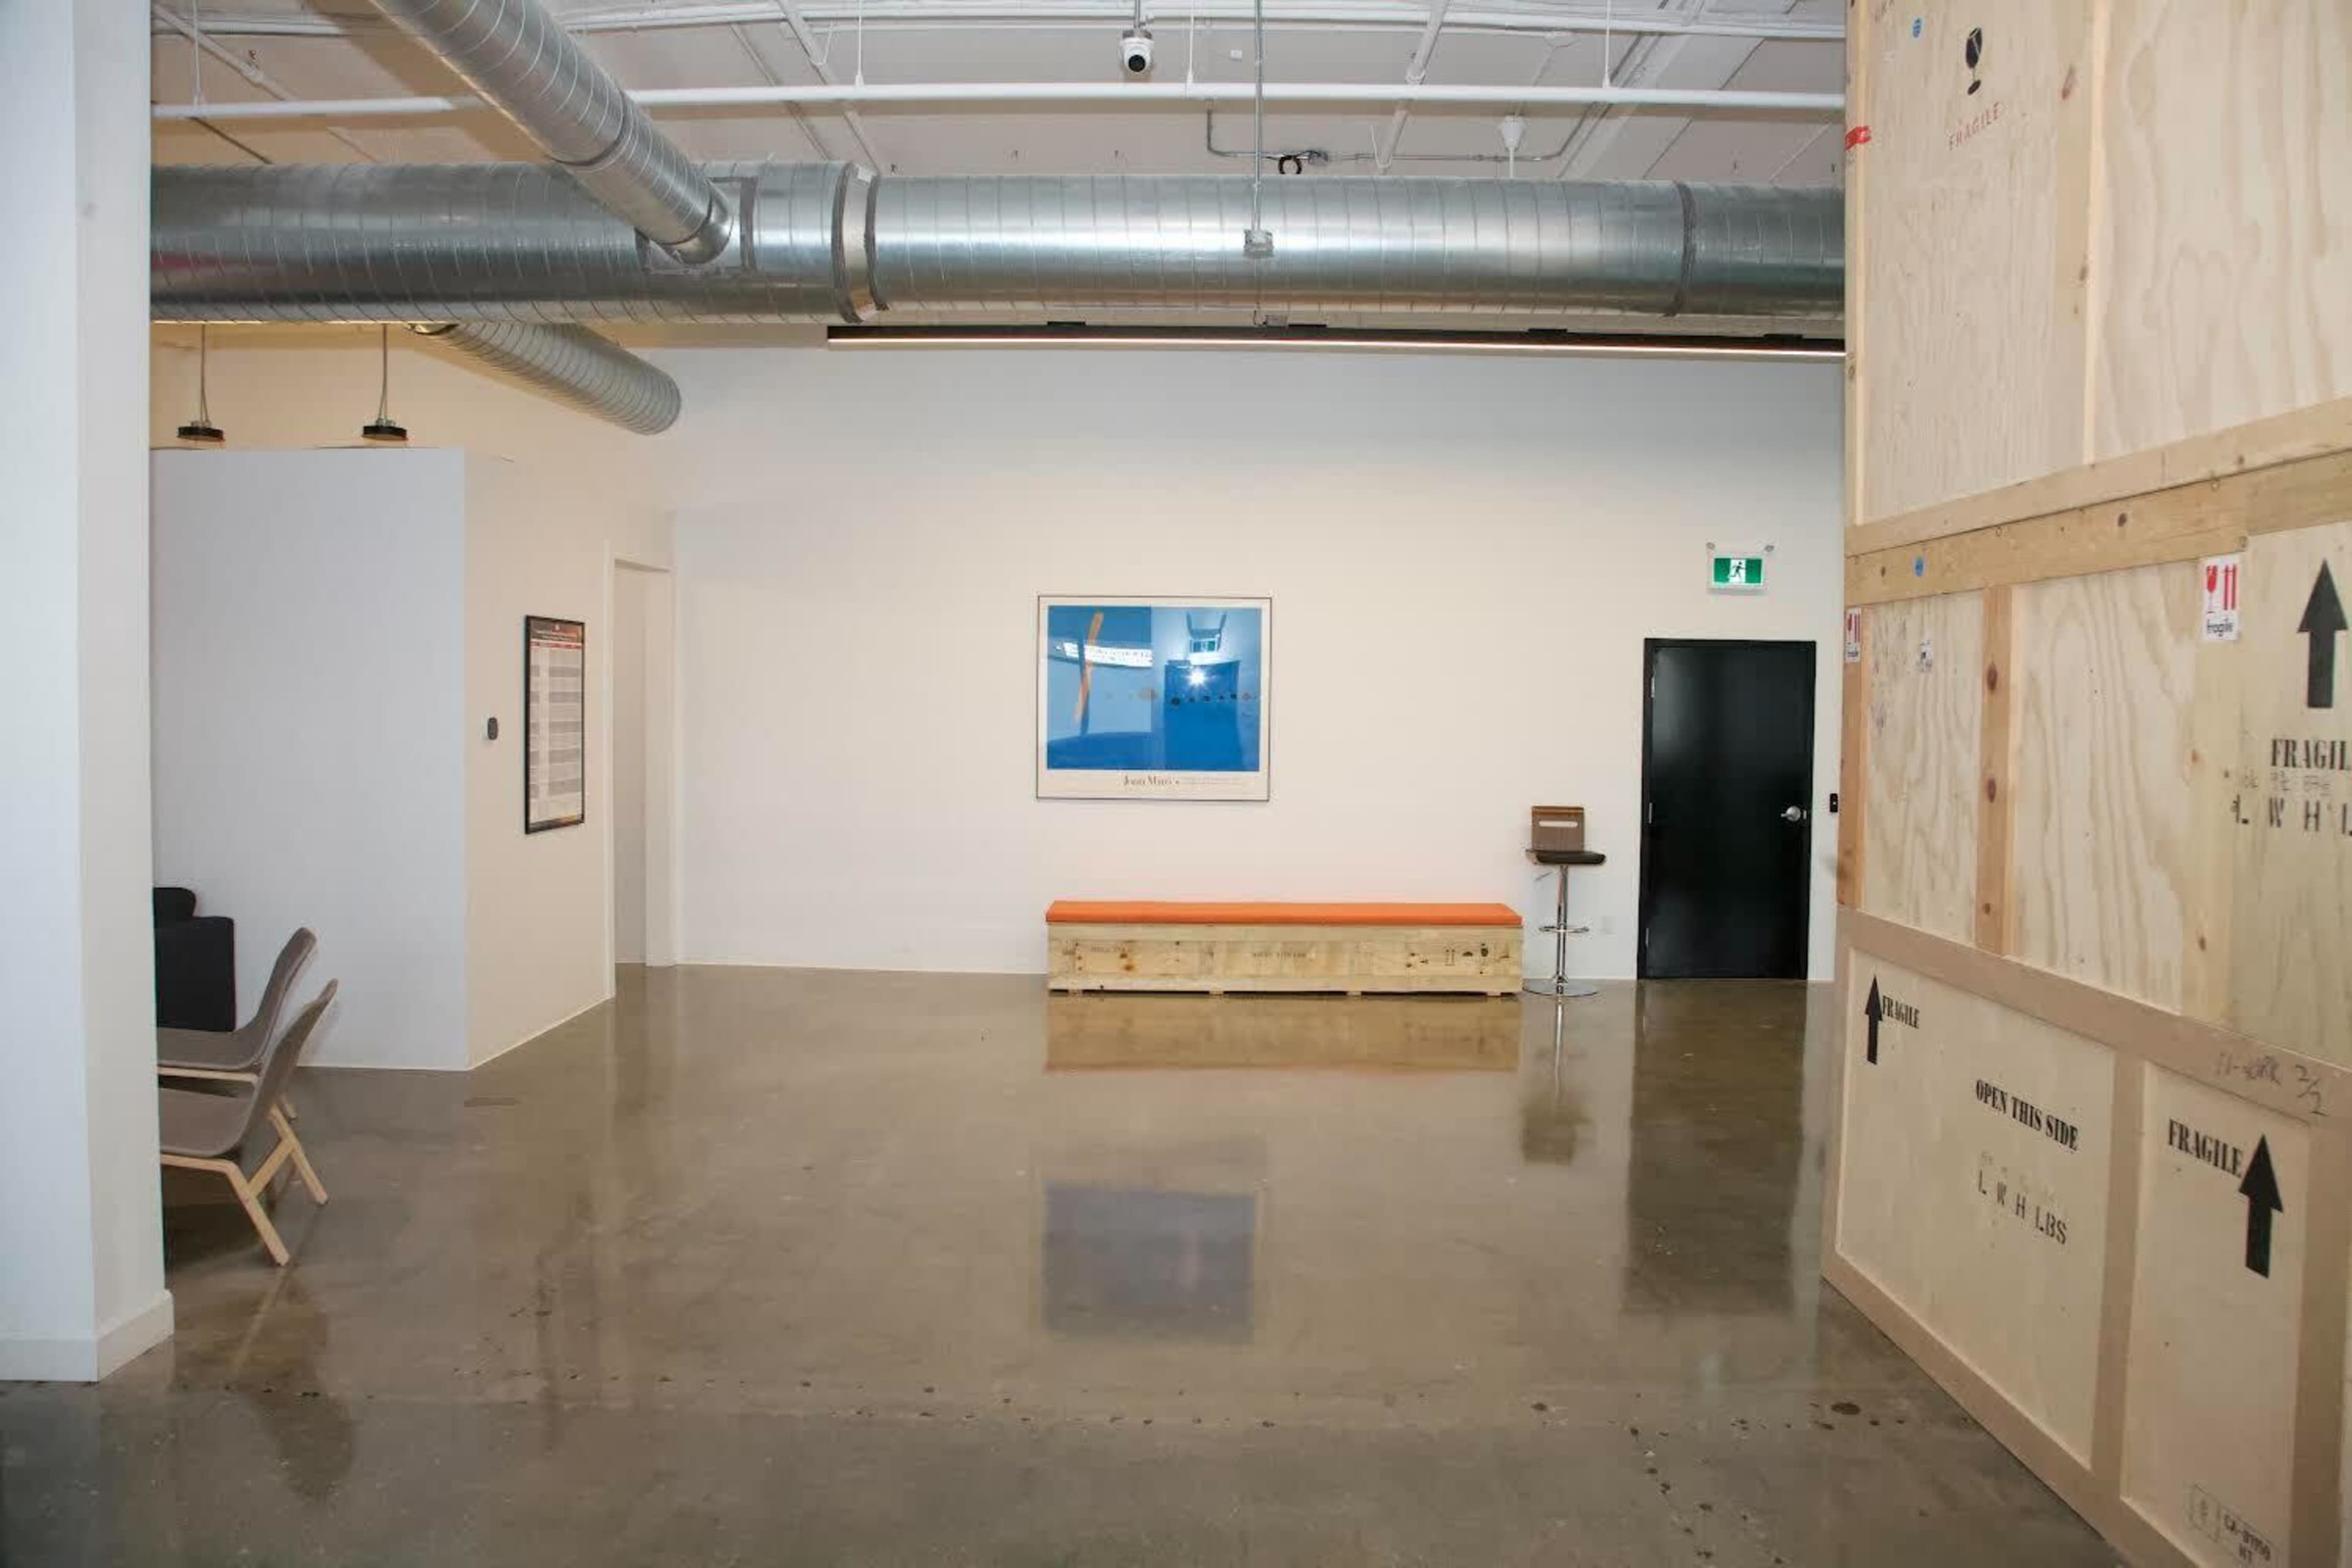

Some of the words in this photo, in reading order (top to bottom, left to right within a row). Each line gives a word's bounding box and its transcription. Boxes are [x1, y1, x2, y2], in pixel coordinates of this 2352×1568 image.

[1948, 101, 2000, 151] FRAGILE
[2269, 797, 2285, 827] W
[2304, 800, 2320, 832] H
[1882, 995, 1920, 1029] FRAGILE
[1976, 1079, 2008, 1114] OPEN
[2011, 1096, 2042, 1132] THIS
[2046, 1114, 2078, 1152] SIDE
[2169, 1118, 2244, 1178] FRAGILE
[2015, 1193, 2026, 1219] H
[2035, 1205, 2068, 1245] LBS
